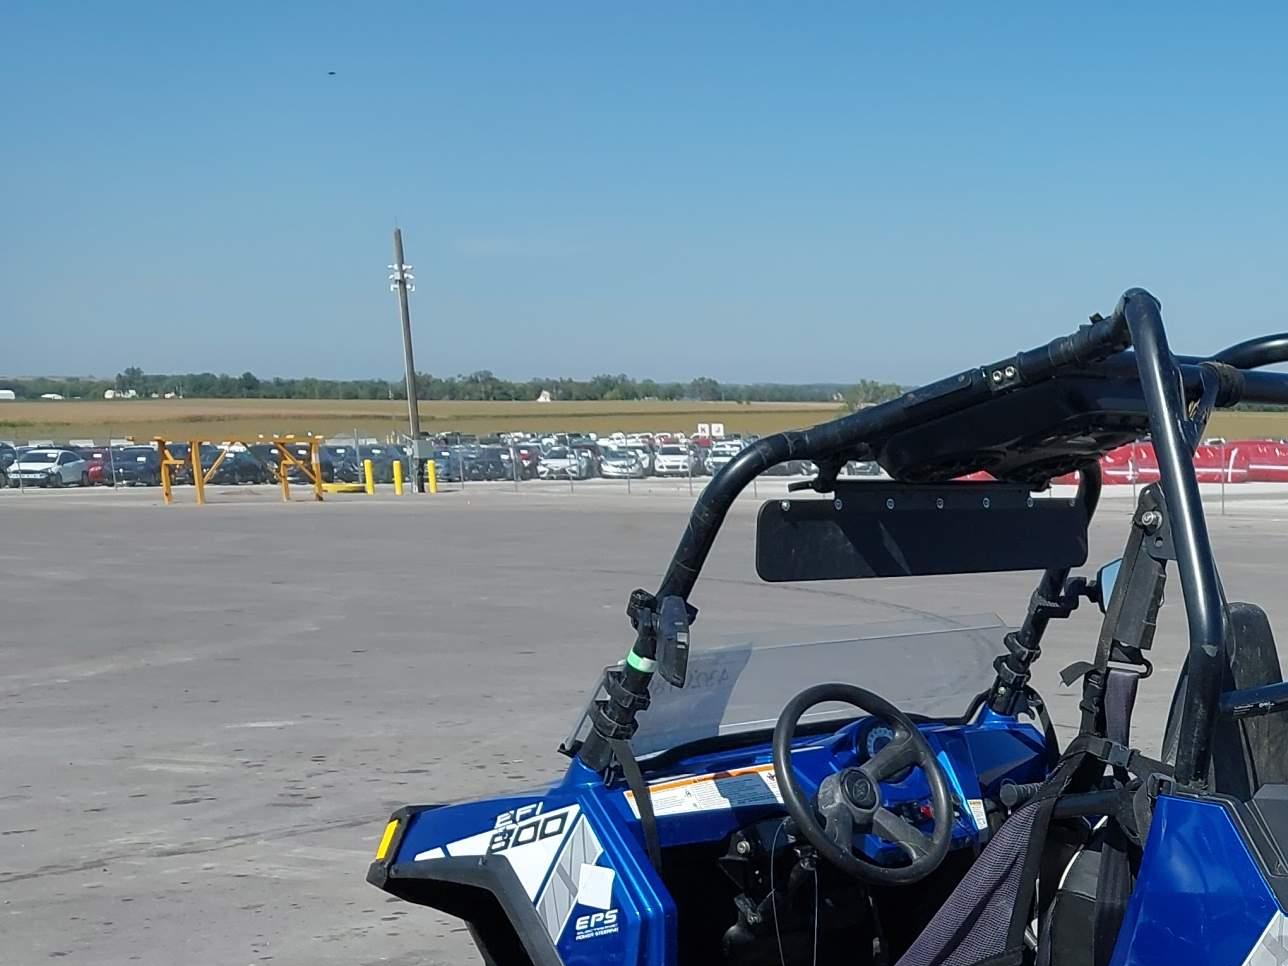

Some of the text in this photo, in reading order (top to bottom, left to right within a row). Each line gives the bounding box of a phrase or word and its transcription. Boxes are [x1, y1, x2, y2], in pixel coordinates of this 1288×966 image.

[494, 801, 544, 829] EFI
[489, 811, 569, 854] 800
[575, 908, 619, 931] EPS
